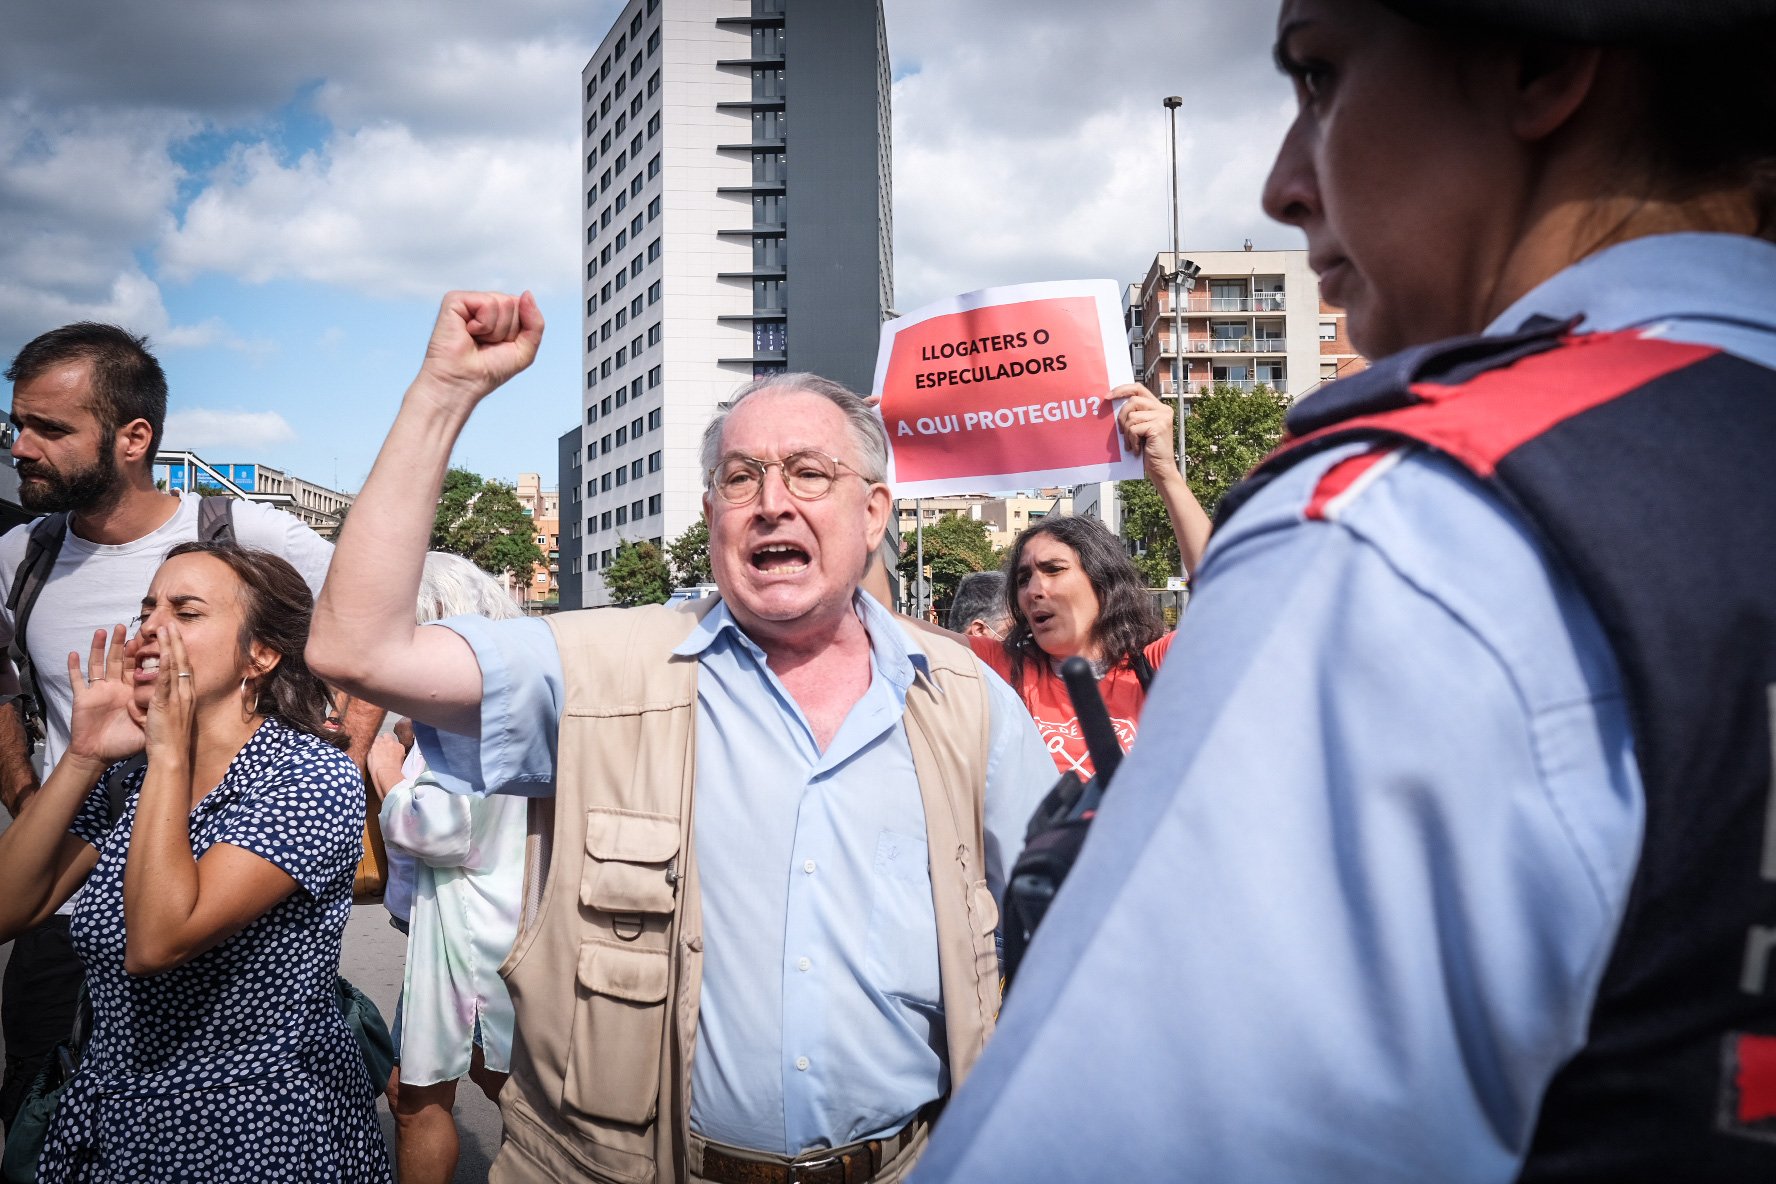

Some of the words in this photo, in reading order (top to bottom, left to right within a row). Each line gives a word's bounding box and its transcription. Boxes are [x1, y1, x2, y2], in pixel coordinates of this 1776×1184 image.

[922, 331, 1027, 361] LLOGATERS
[1033, 329, 1050, 345] O
[915, 355, 1068, 389] ESPECULADORS
[897, 420, 914, 437] A
[916, 414, 959, 435] QUI
[964, 396, 1101, 431] PROTEGIU?
